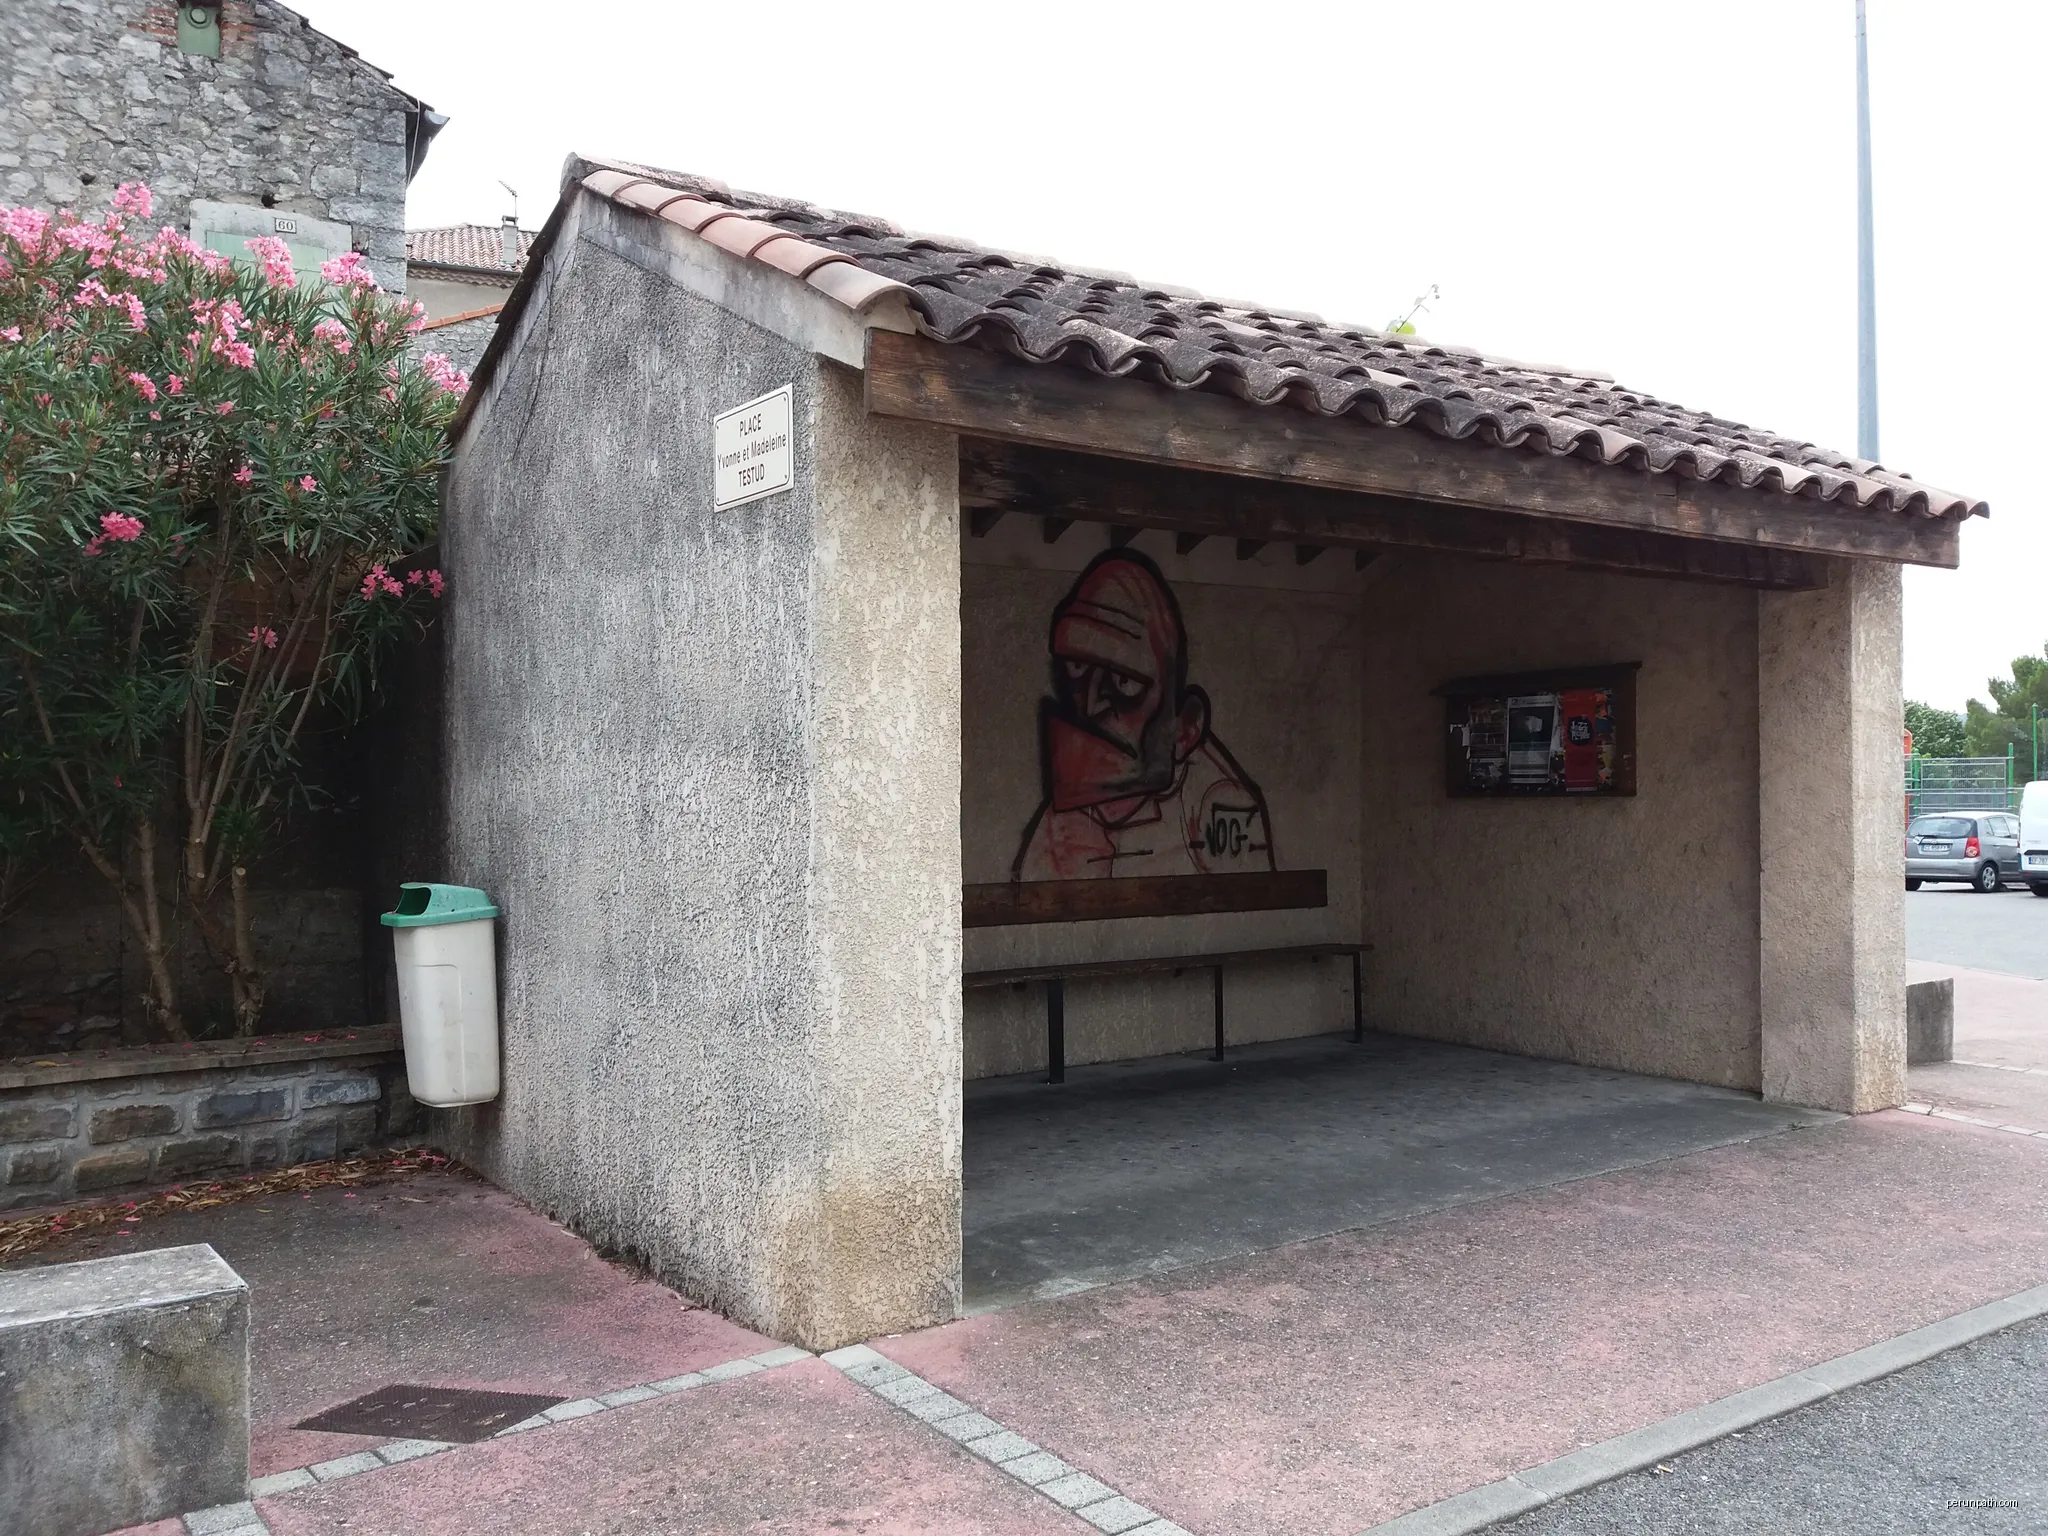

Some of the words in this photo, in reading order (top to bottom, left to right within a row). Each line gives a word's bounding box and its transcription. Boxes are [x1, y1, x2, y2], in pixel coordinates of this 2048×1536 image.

[278, 220, 293, 231] 60
[740, 413, 762, 437] PLACE
[717, 451, 740, 470] Yvonne
[743, 445, 750, 461] et
[751, 432, 787, 458] Madeleine
[739, 463, 765, 487] TESTUD
